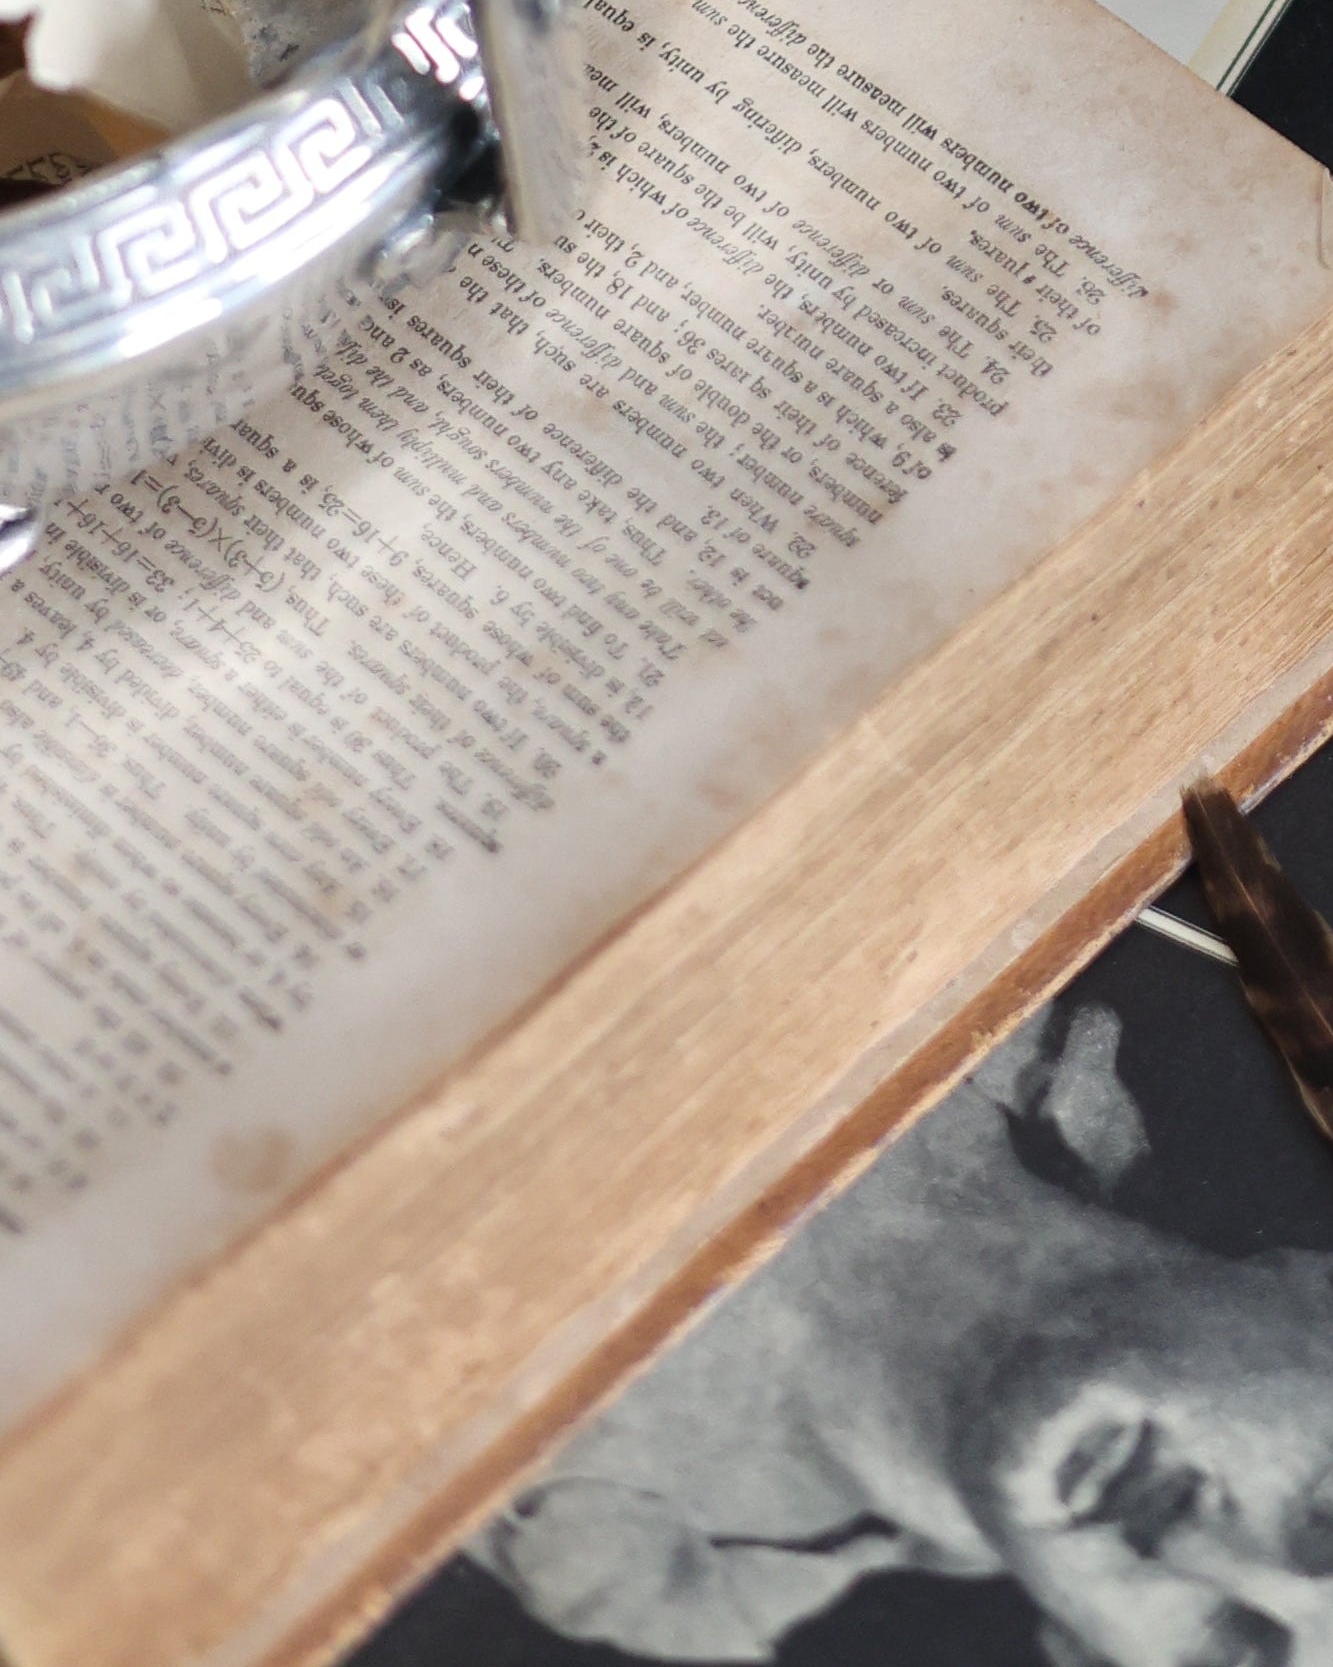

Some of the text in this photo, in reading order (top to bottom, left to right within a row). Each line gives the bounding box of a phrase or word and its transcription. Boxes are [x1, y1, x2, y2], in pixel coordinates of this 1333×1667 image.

[636, 31, 657, 52] is
[726, 24, 757, 50] the
[658, 41, 706, 84] unity,
[806, 43, 836, 70] the
[756, 45, 827, 99] measure
[704, 80, 731, 105] by
[836, 64, 908, 117] measure
[820, 94, 859, 123] will
[731, 97, 803, 156] differing
[901, 112, 939, 141] will
[597, 151, 618, 171] is
[860, 119, 934, 173] numbers
[807, 148, 882, 211] numbers,
[940, 137, 1015, 194] numbers
[615, 163, 667, 206] which
[932, 170, 967, 200] two
[660, 202, 690, 219] of
[961, 196, 991, 214] of
[1014, 191, 1050, 222] two
[583, 218, 626, 253] their
[614, 91, 1011, 385] 24. The sum or difference of two numbers, will
[884, 211, 919, 240] two
[994, 214, 1032, 244] sum
[1040, 217, 1070, 235] of
[624, 243, 646, 268] 2,
[685, 217, 765, 276] difference
[913, 236, 943, 255] of
[1034, 243, 1070, 278] The
[481, 255, 527, 294] these
[576, 252, 607, 279] the
[588, 106, 1010, 418] product increased by unity, will be the square of the
[638, 260, 680, 289] and
[945, 254, 984, 284] sum
[459, 276, 489, 304] the
[517, 290, 547, 308] of
[605, 270, 634, 300] 18,
[763, 273, 794, 300] the
[629, 293, 671, 323] and
[680, 281, 748, 342] number,
[940, 285, 1009, 341] squares.
[986, 284, 1022, 318] The
[1034, 284, 1079, 320] their
[489, 302, 530, 336] that
[798, 293, 874, 357] numbers,
[1029, 314, 1058, 344] 25.
[1071, 317, 1102, 336] of
[406, 315, 473, 369] squares
[532, 330, 577, 373] such,
[545, 308, 623, 370] difference
[673, 319, 706, 355] 36;
[745, 337, 804, 384] square
[873, 354, 909, 385] two
[472, 369, 516, 406] their
[536, 258, 885, 527] numbers, or the double of square numbers.
[579, 373, 610, 399] are
[617, 366, 659, 396] and
[803, 379, 819, 394] a
[825, 357, 885, 404] square
[900, 379, 930, 402] If
[509, 404, 539, 421] of
[657, 394, 696, 424] sum
[816, 391, 837, 408] is
[884, 400, 900, 416] a
[931, 398, 963, 428] 23.
[611, 399, 688, 460] numbers
[772, 400, 818, 437] their
[835, 404, 888, 450] which
[899, 413, 937, 444] also
[695, 421, 726, 450] the
[812, 433, 841, 452] of
[542, 422, 623, 488] difference
[891, 442, 912, 468] 9,
[690, 458, 726, 489] two
[626, 487, 658, 515] the
[729, 487, 780, 535] When
